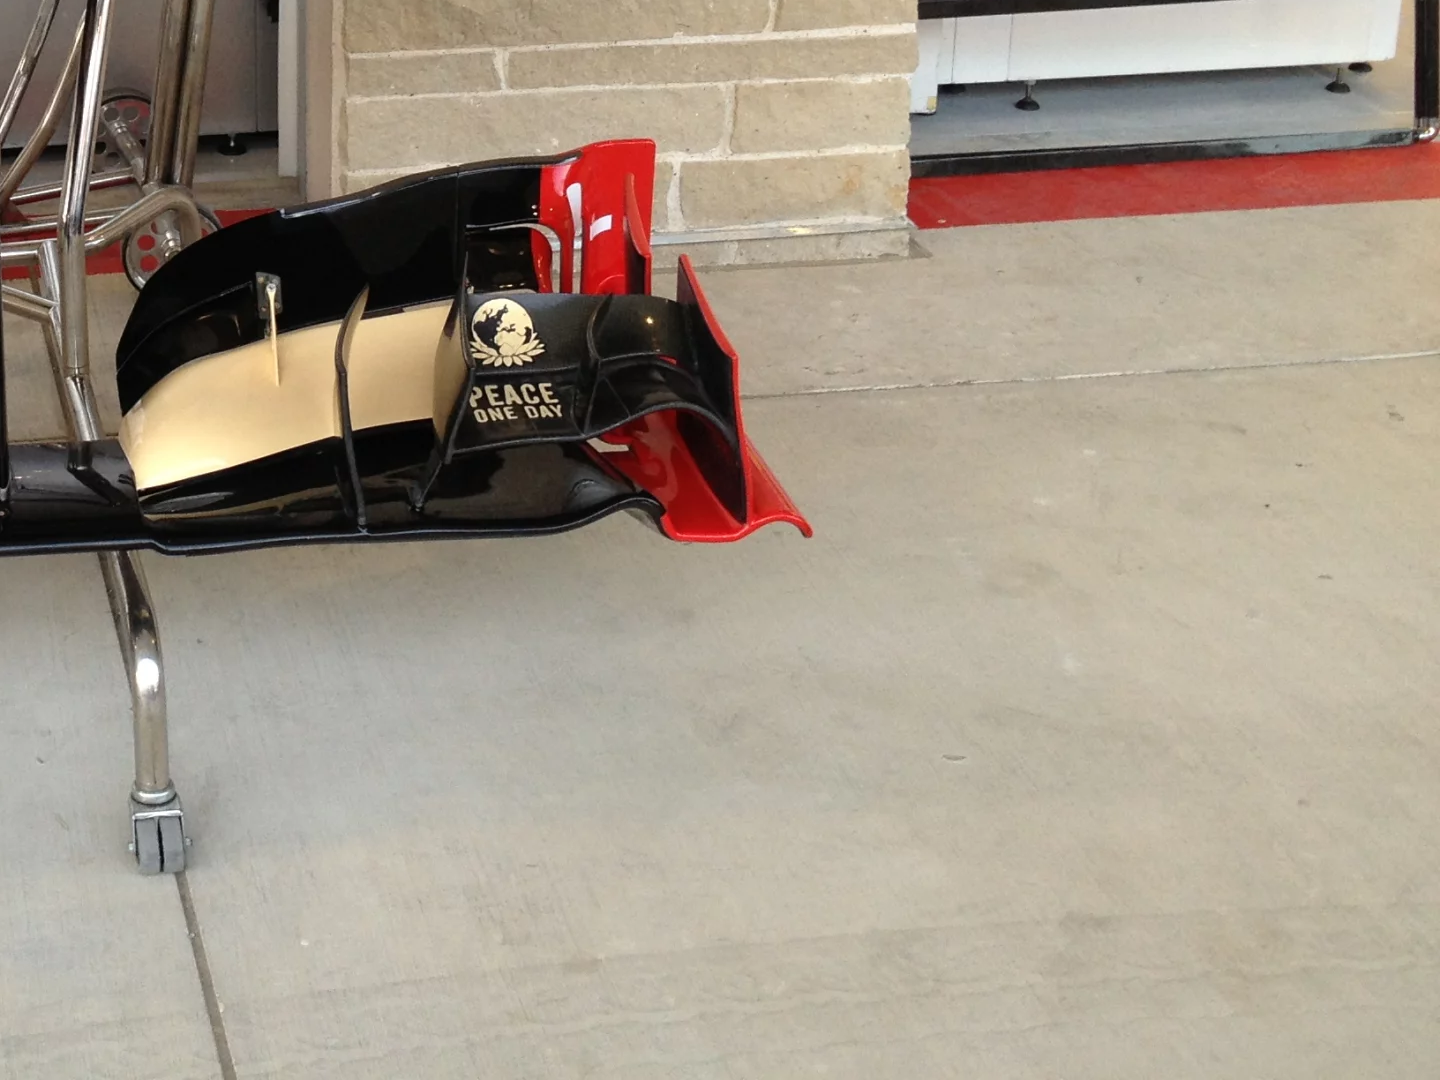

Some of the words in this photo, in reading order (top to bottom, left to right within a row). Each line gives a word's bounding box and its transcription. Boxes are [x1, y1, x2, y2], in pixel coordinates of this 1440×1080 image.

[469, 382, 560, 408] PEACE
[473, 406, 519, 423] ONE
[523, 404, 563, 418] DAY
